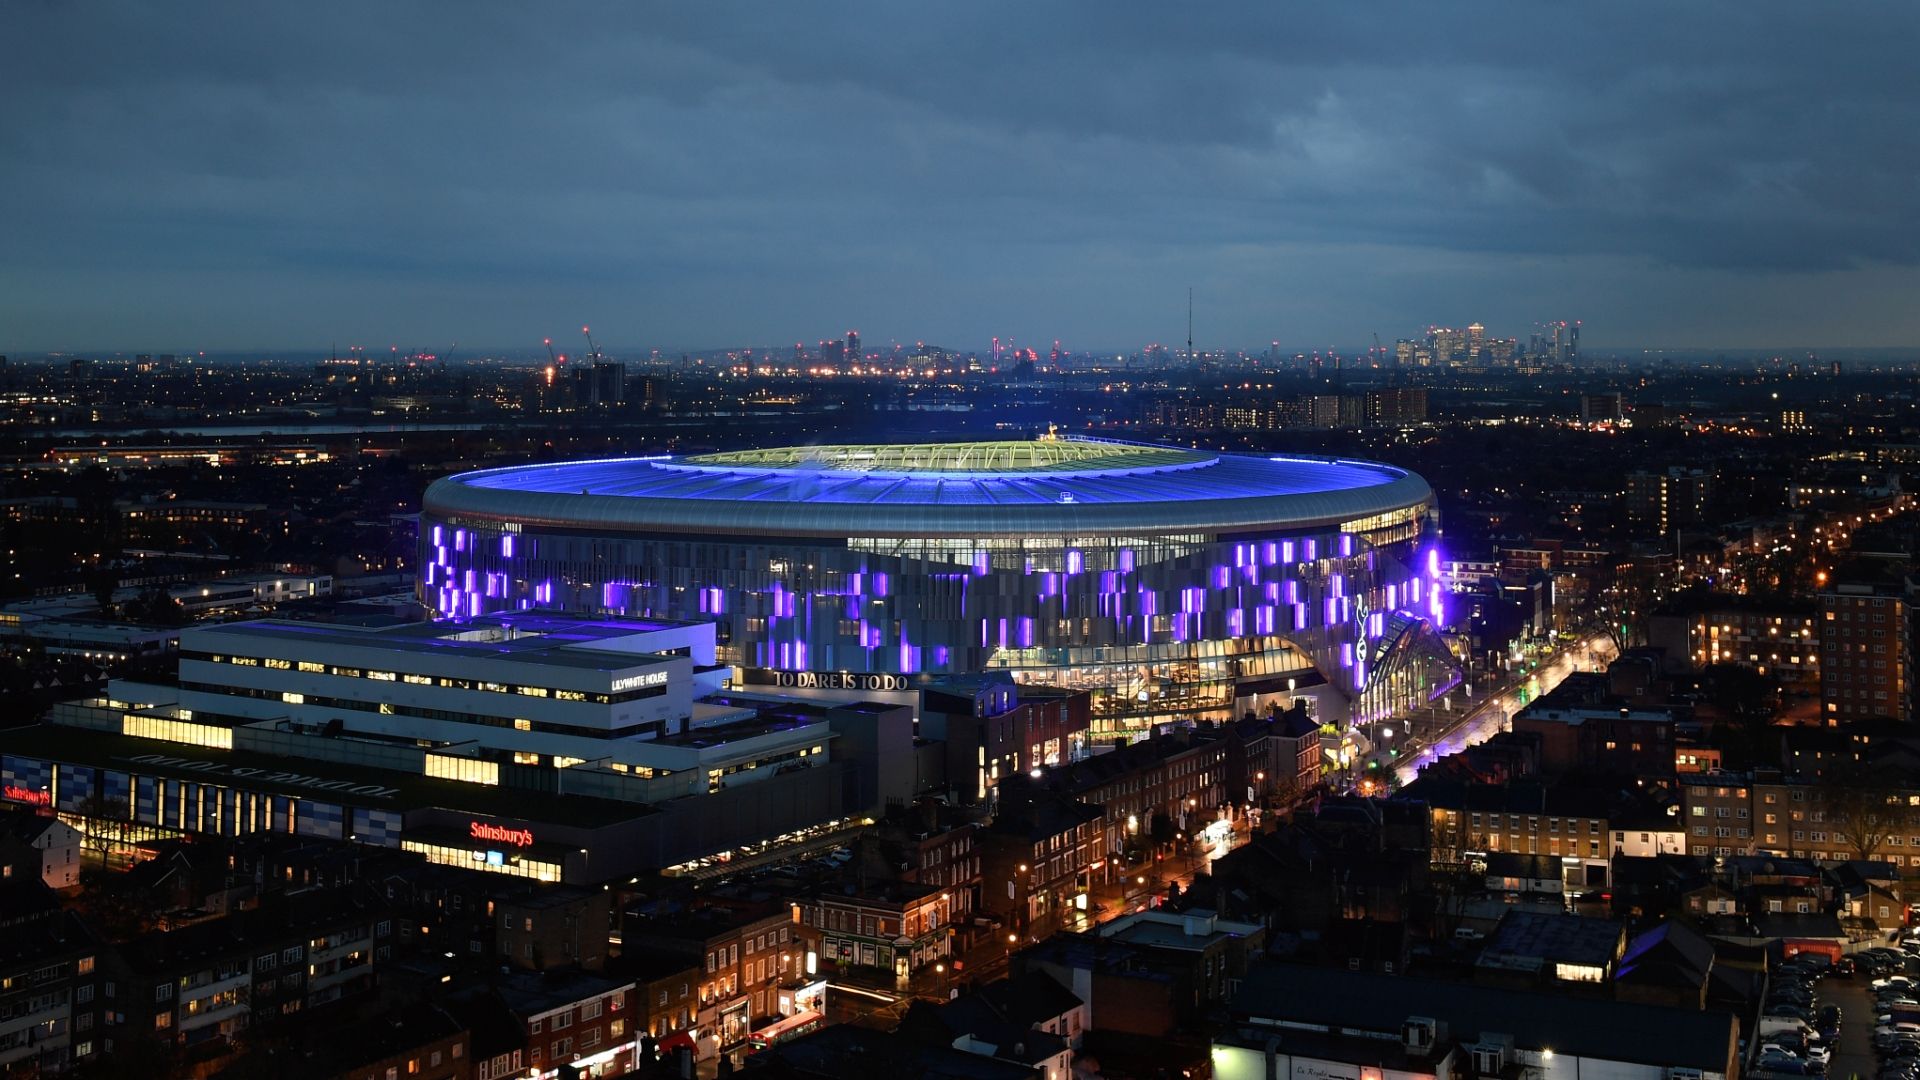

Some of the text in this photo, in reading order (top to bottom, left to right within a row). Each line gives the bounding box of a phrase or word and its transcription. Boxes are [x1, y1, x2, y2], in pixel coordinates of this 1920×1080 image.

[611, 671, 668, 691] LILYWHITE HOUSE
[774, 671, 908, 690] TO DARE IS TO DO
[4, 785, 50, 805] Sainsbury's
[470, 822, 532, 847] Sainsbury's
